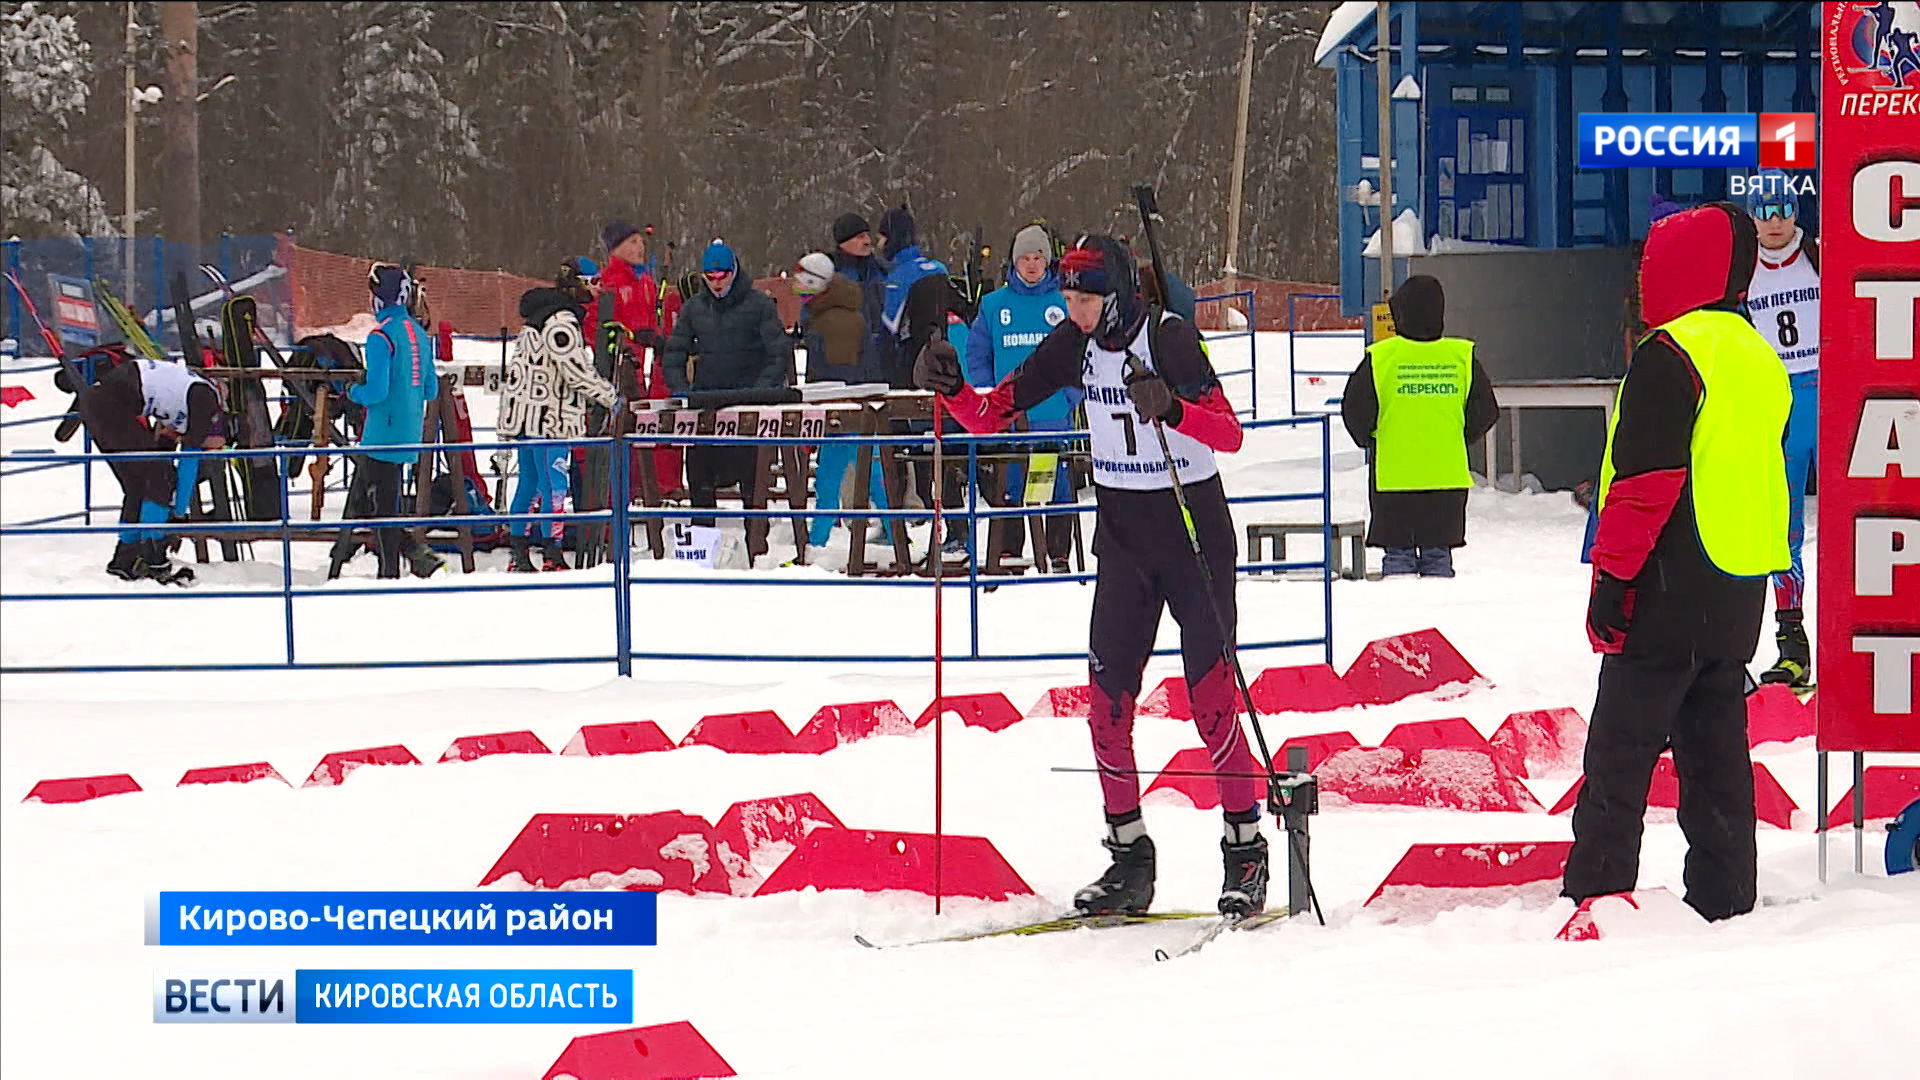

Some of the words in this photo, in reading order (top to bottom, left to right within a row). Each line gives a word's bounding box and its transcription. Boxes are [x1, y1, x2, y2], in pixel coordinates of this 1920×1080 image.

[1840, 92, 1920, 116] ПЕРЕК
[1000, 309, 1011, 326] 6
[1777, 310, 1799, 347] 8
[1003, 333, 1049, 347] КОМАН
[716, 421, 736, 436] 28
[759, 419, 779, 437] 29
[802, 419, 823, 437] 30
[1111, 413, 1137, 455] 7
